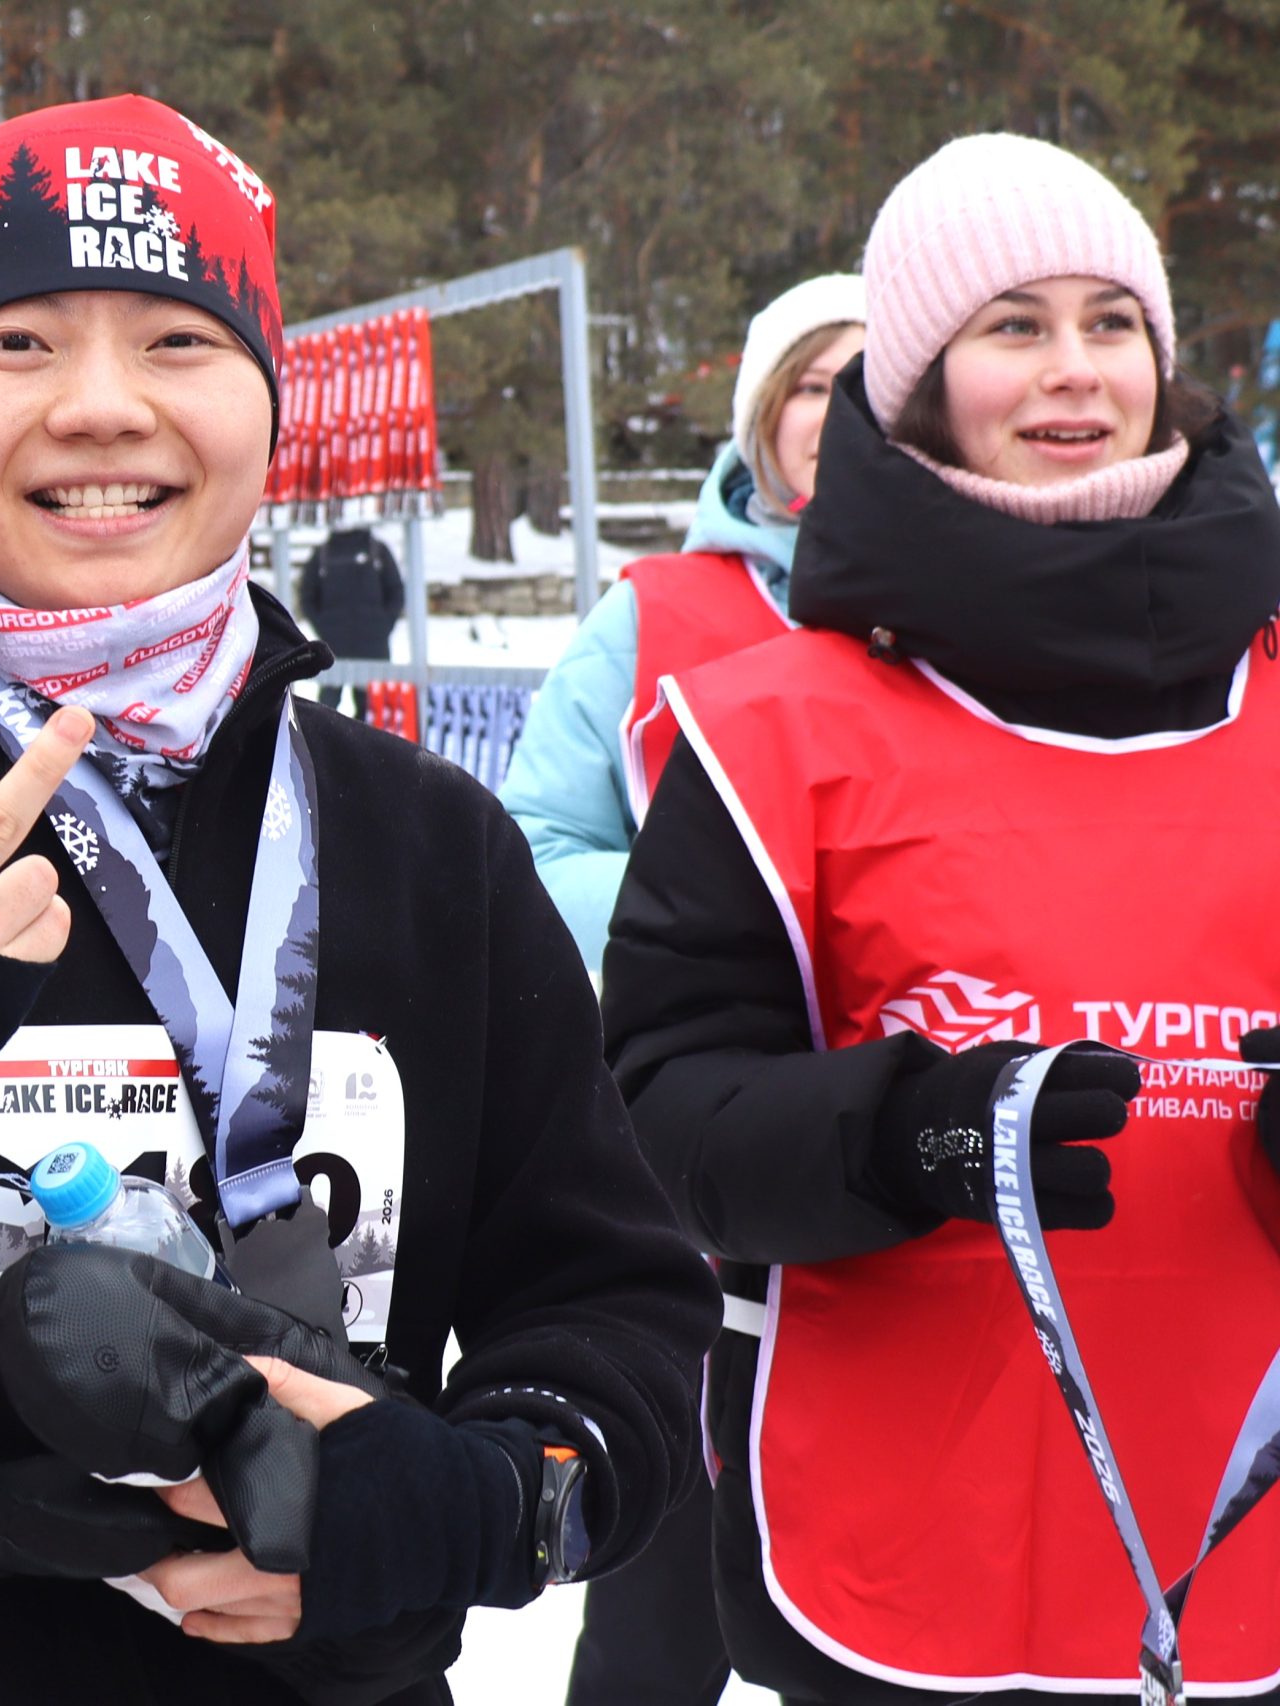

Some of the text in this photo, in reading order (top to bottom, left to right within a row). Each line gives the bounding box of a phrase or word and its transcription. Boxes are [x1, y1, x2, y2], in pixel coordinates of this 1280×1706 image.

[65, 146, 181, 194] LAKE
[67, 183, 146, 225] ICE
[69, 226, 189, 282] RACE
[4, 628, 86, 646] SPORTS
[1073, 1001, 1280, 1053] ТУРГО
[48, 1060, 129, 1077] ТУРГОЯК
[65, 1084, 106, 1113] ICE
[121, 1084, 179, 1113] RACE
[1125, 1096, 1233, 1119] ТИВАЛЬ
[381, 1188, 393, 1225] 2026
[994, 1108, 1058, 1322] LAKE ICE RACE
[1074, 1408, 1121, 1505] 2026
